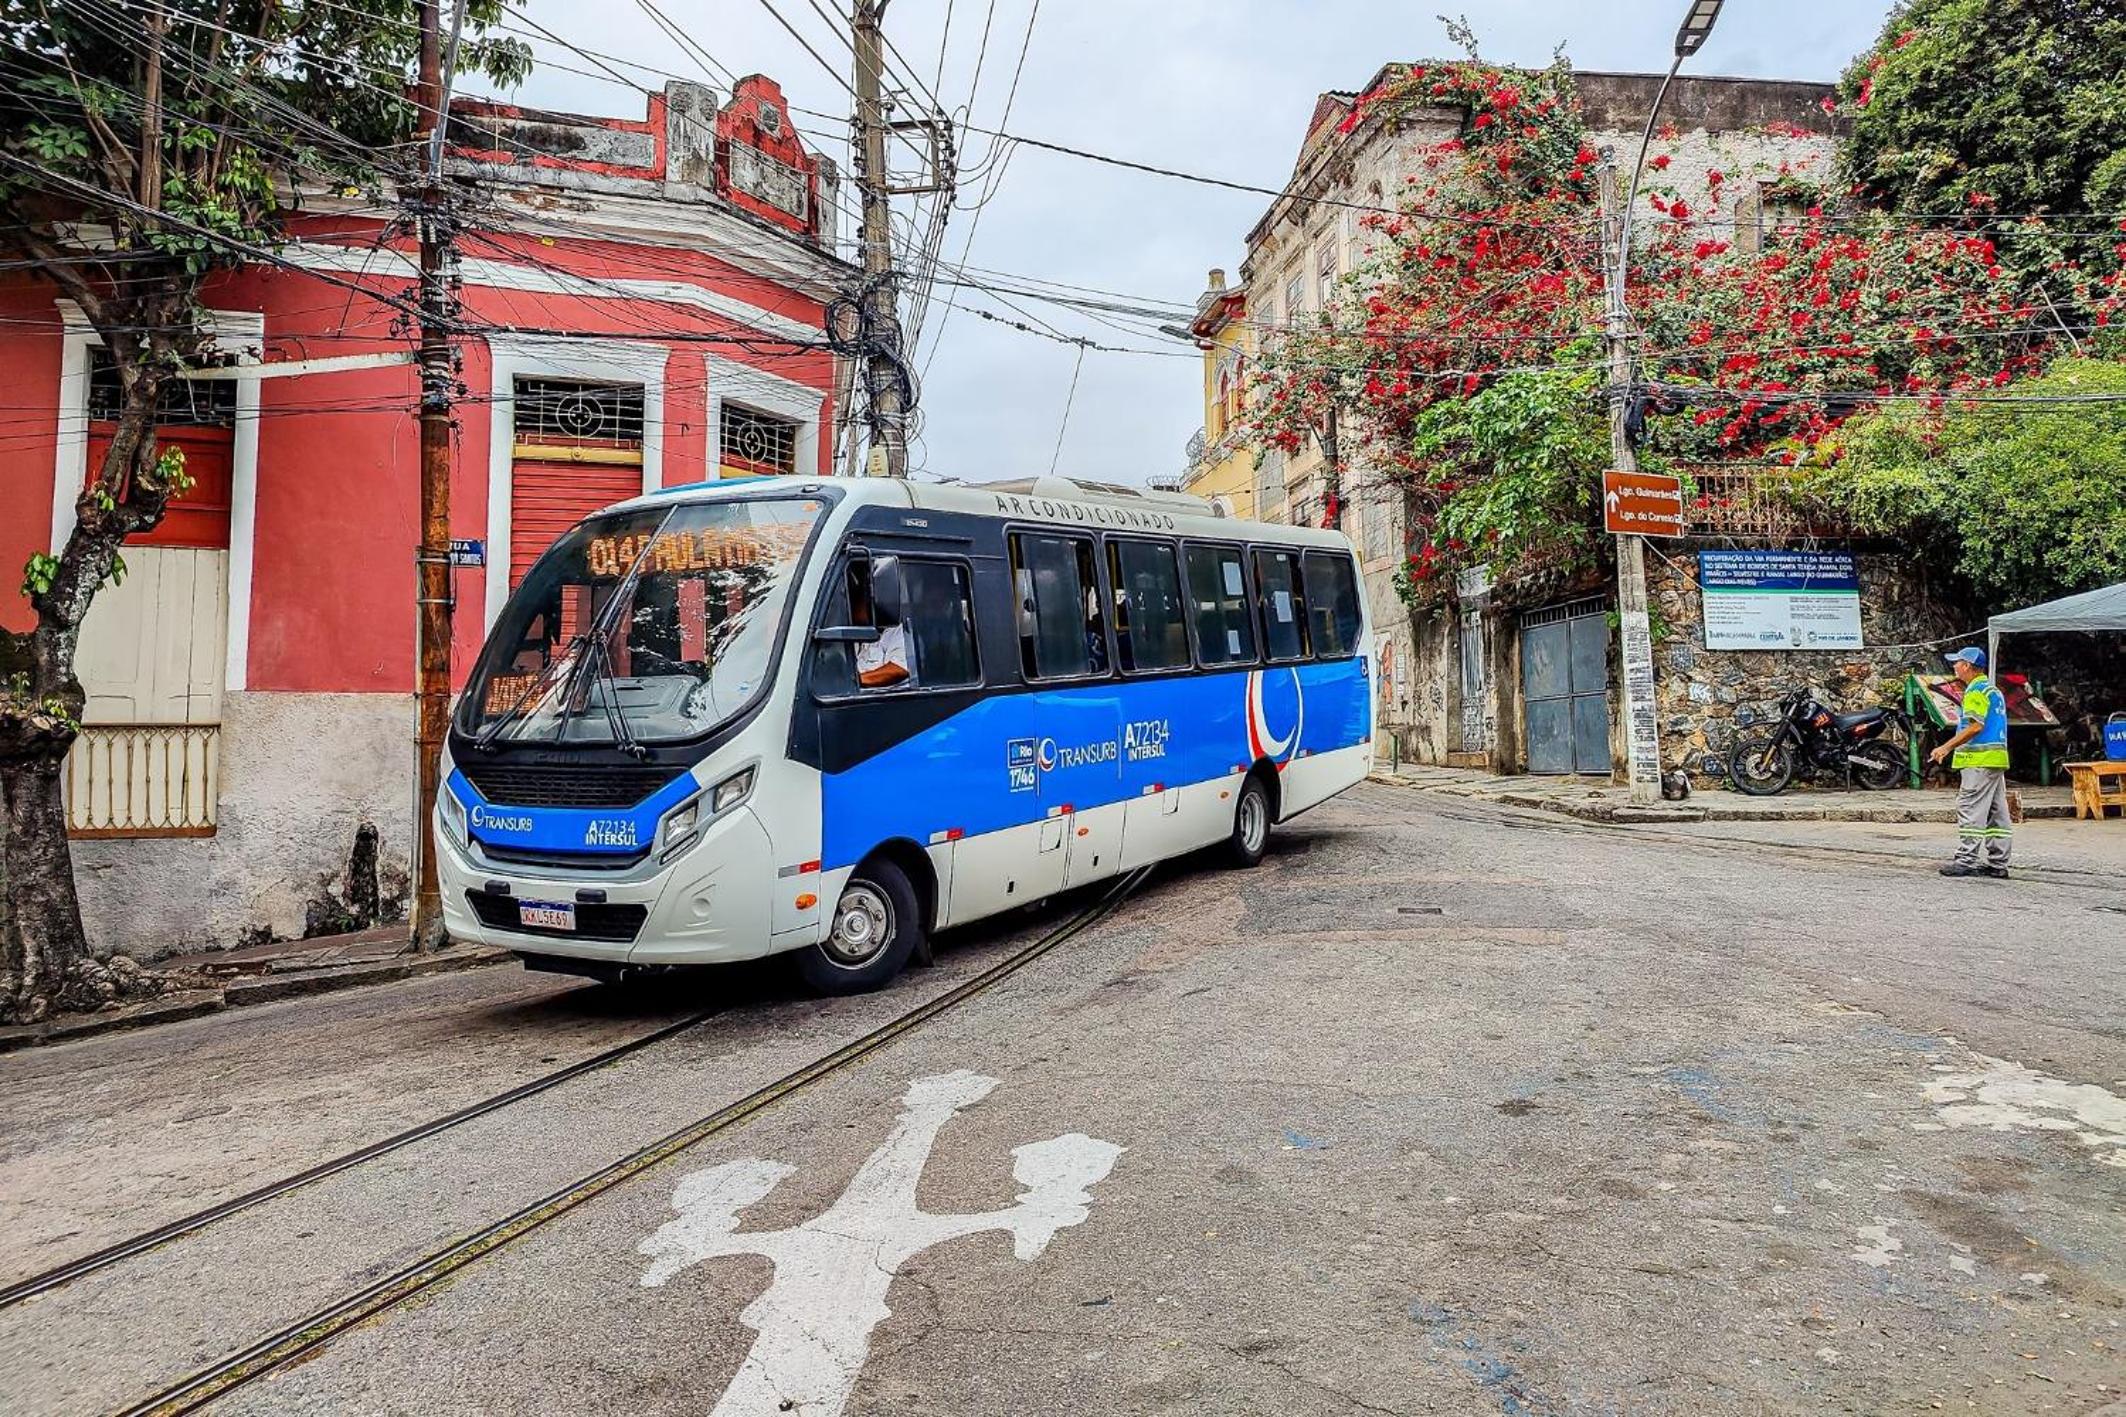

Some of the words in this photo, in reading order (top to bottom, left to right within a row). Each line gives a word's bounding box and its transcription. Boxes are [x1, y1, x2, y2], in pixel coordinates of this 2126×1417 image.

[995, 495, 1024, 514] AR
[1031, 501, 1174, 529] CONDICIONADO
[1124, 719, 1170, 749] A72134
[1019, 744, 1032, 758] Rio
[1058, 741, 1117, 768] TRANSURB
[1128, 744, 1166, 762] INTERSUL
[1009, 766, 1035, 788] 1746
[485, 815, 533, 832] TRANSURB
[588, 820, 636, 834] A72134
[585, 832, 639, 846] INTERSUL
